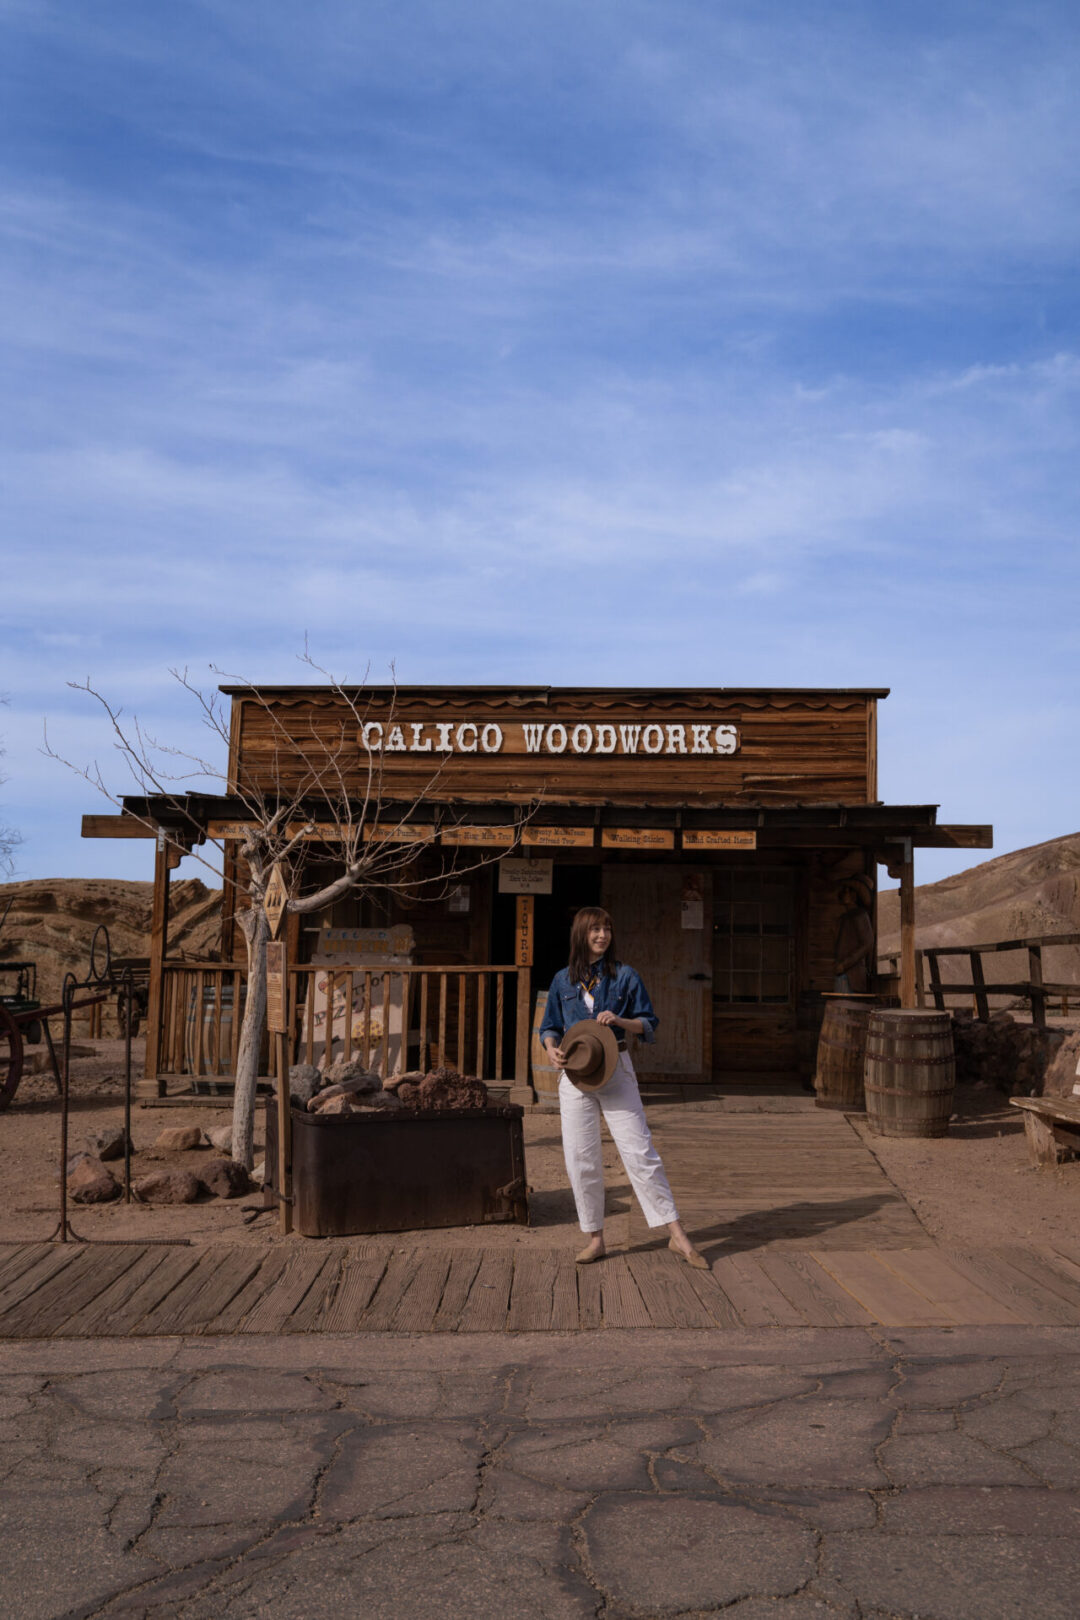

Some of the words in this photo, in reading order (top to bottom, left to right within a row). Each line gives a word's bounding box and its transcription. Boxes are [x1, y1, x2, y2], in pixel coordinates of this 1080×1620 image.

[362, 722, 503, 752] CALICO
[522, 723, 738, 754] WOODWORKS
[706, 835, 731, 844] Crafted
[733, 835, 754, 844] Items
[520, 899, 529, 963] TOURS
